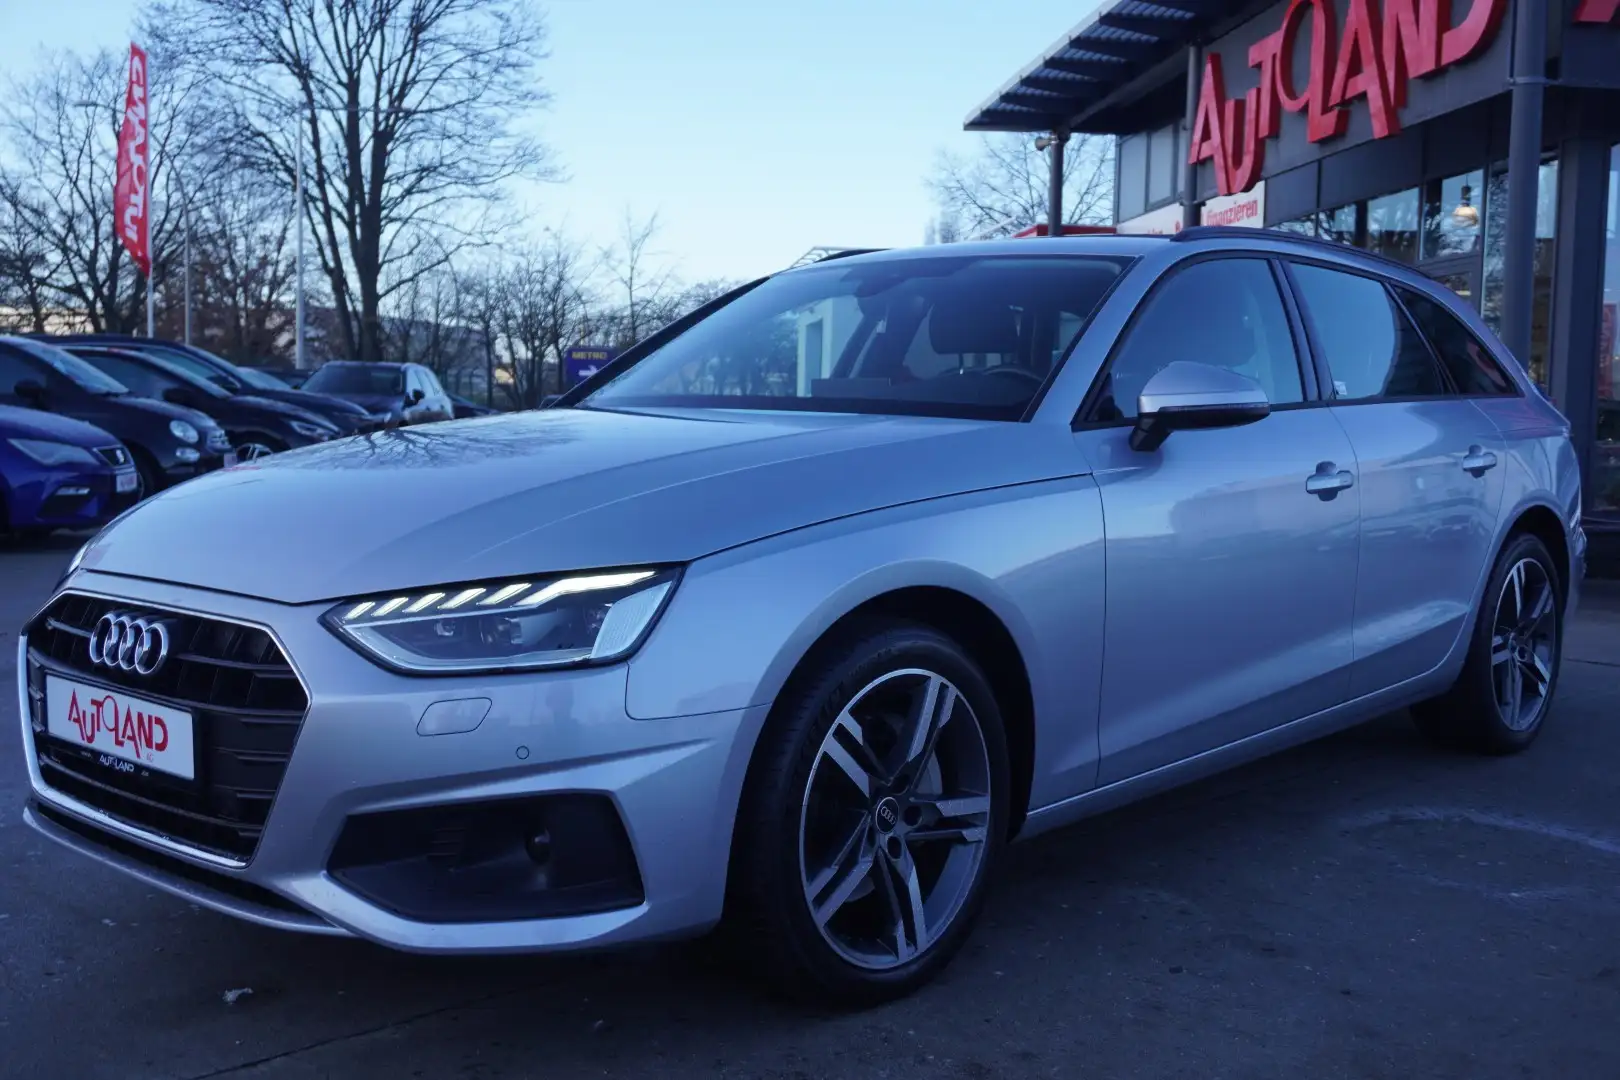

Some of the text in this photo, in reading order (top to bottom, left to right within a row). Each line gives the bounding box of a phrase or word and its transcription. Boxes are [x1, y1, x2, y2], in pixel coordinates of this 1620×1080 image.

[1188, 0, 1506, 195] AUTOLAND
[571, 351, 608, 360] METRO
[67, 687, 169, 759] AUTOLAND
